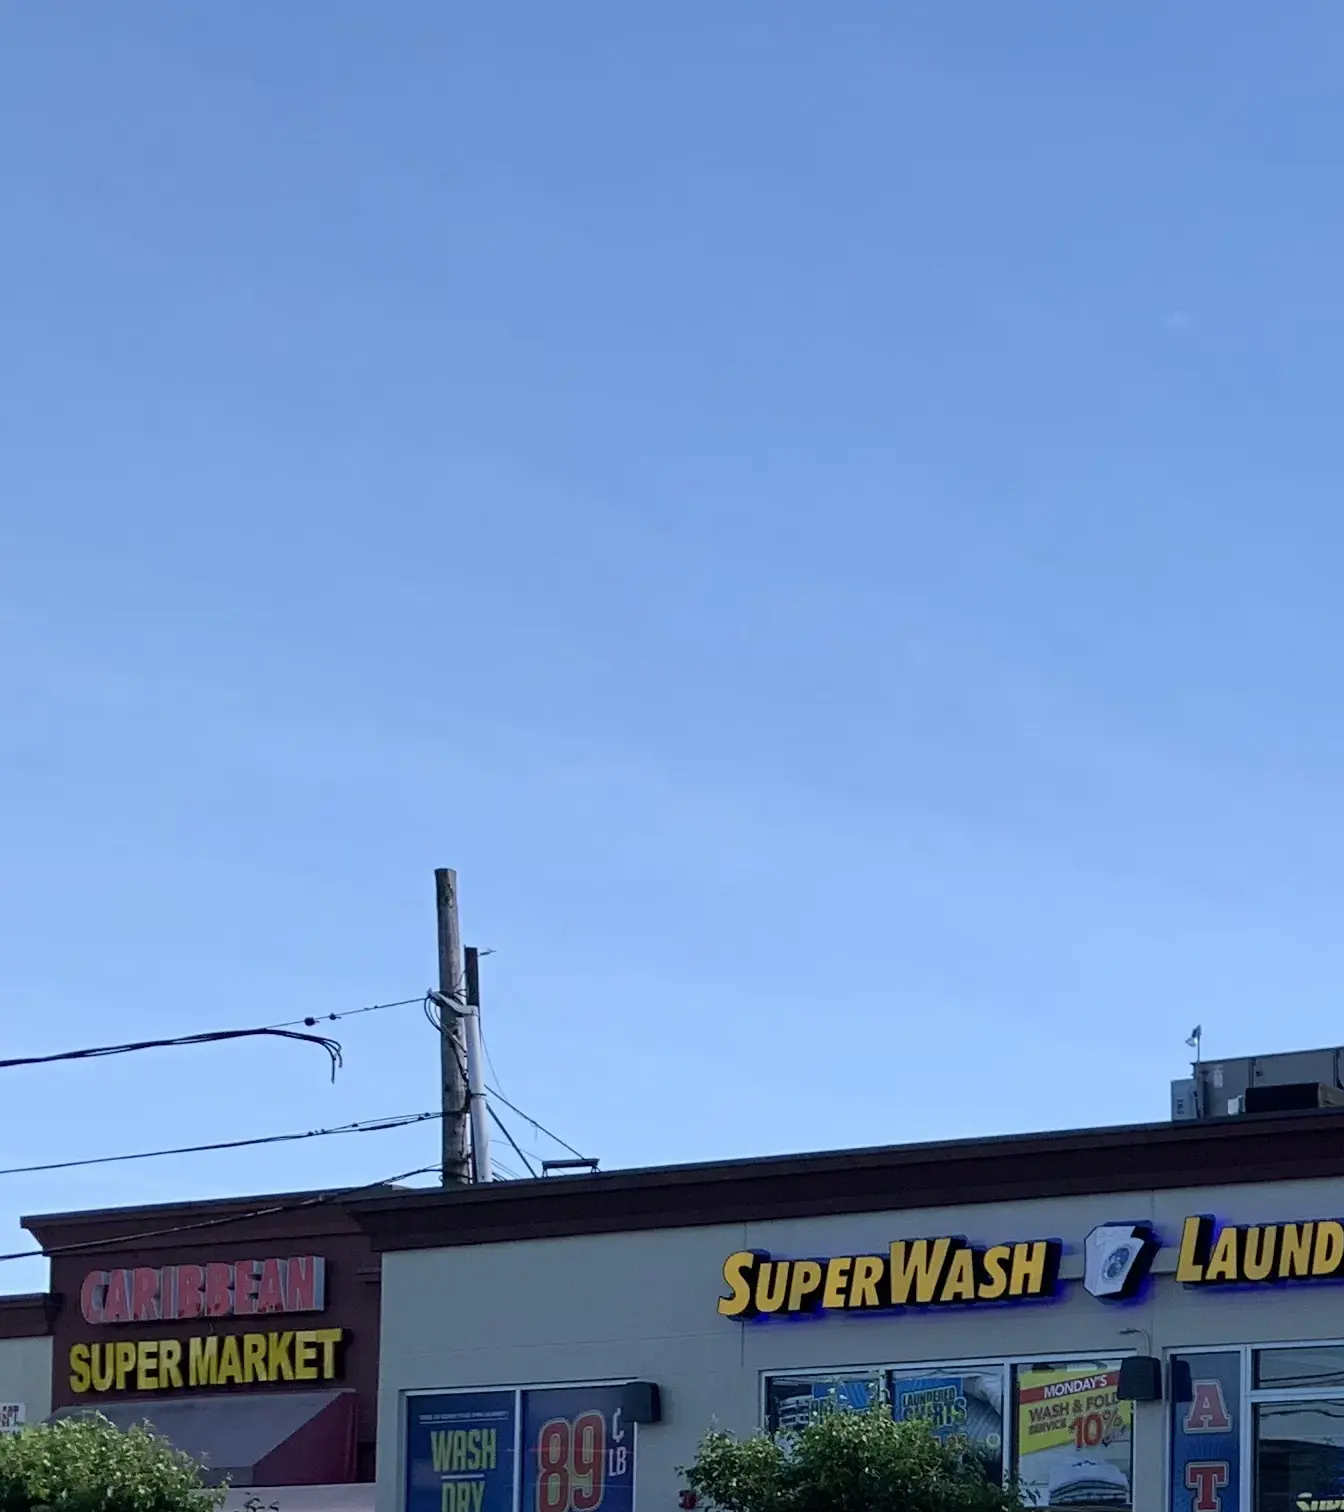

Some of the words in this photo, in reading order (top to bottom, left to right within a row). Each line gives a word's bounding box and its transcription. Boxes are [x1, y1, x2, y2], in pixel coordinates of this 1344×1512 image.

[81, 1255, 325, 1324] CARIBBEAN
[69, 1339, 184, 1393] SUPER
[188, 1327, 344, 1386] MARKET
[1044, 1374, 1107, 1398] MONDAY'S
[1029, 1401, 1069, 1421] WASH
[1073, 1399, 1083, 1412] &
[430, 1428, 497, 1473] WASH
[608, 1446, 627, 1477] LB
